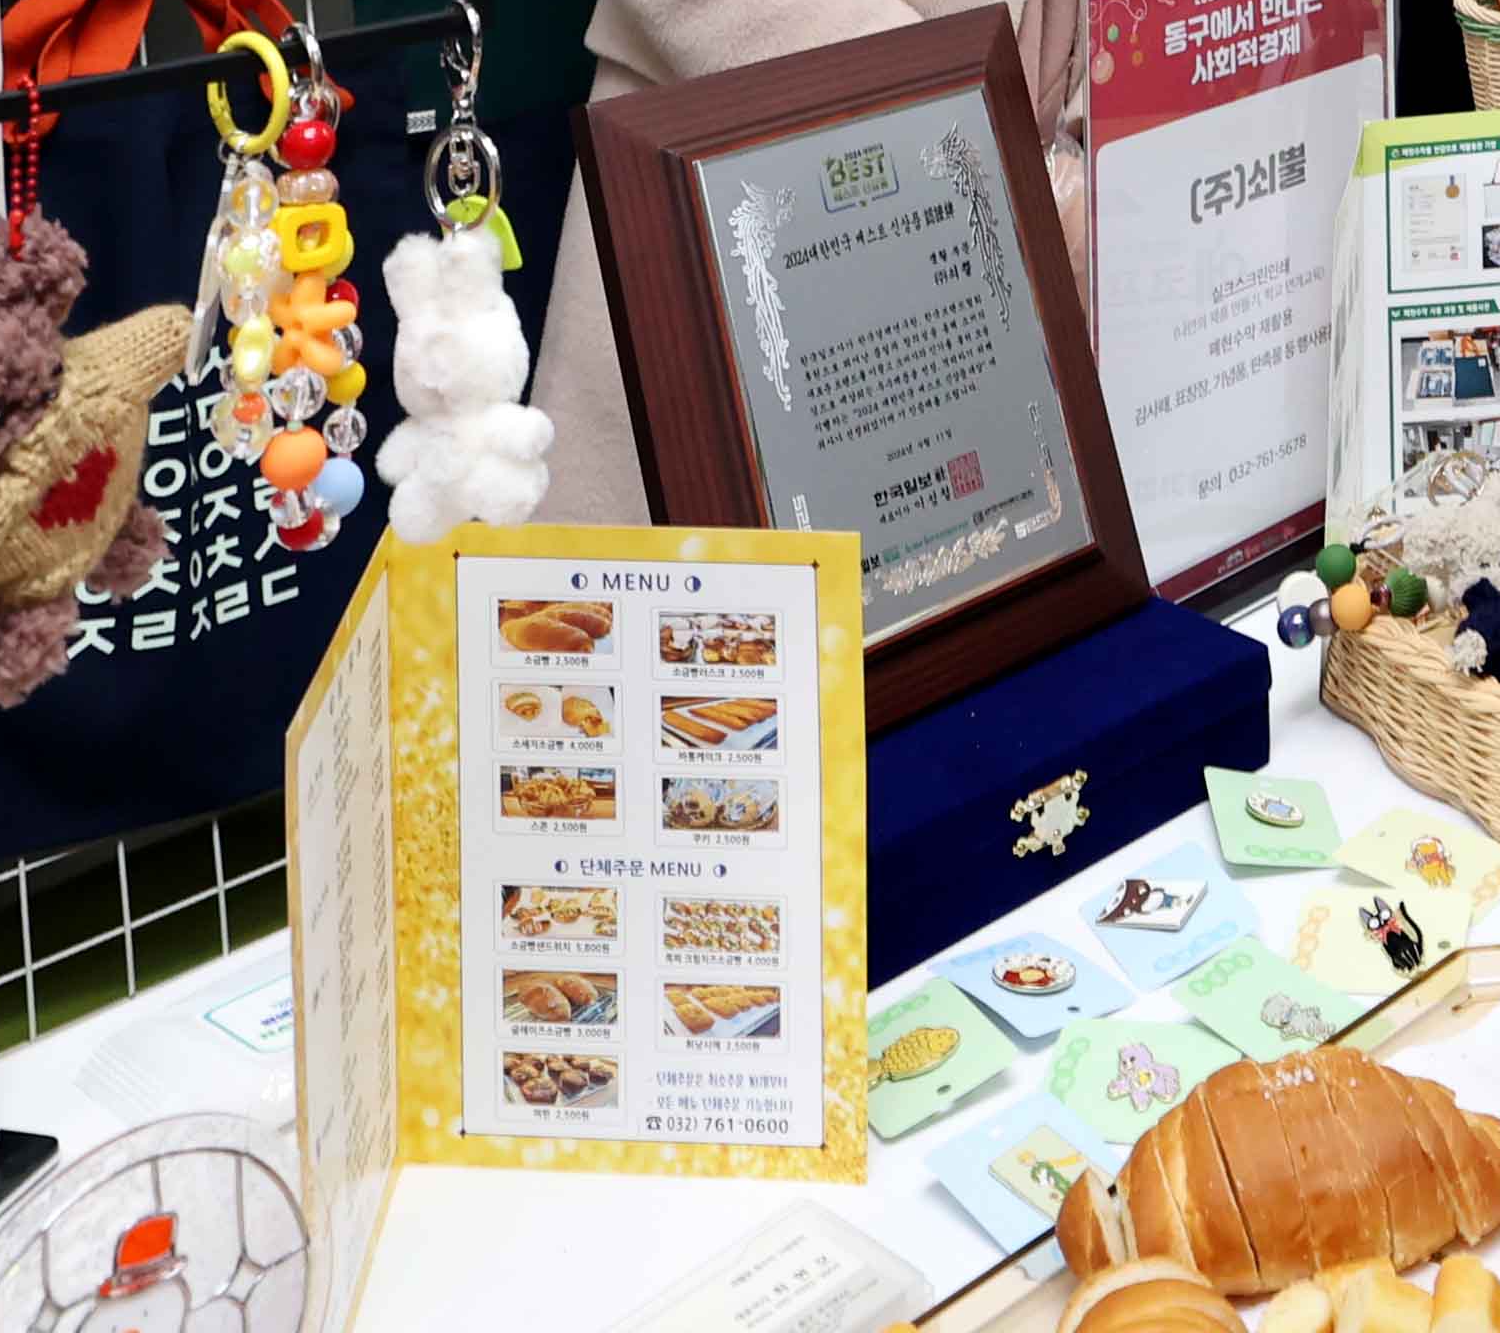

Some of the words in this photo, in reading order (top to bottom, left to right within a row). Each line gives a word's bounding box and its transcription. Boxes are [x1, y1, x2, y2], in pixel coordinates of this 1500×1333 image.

[1164, 0, 1255, 56] 동구에서
[1191, 23, 1301, 85] 사회적경제
[828, 153, 885, 187] BEST
[1190, 142, 1307, 224] (주)쇠뿔
[602, 573, 670, 591] MENU
[524, 655, 550, 666] 소금빵
[580, 859, 645, 877] 단체주문
[650, 861, 702, 877] MENU
